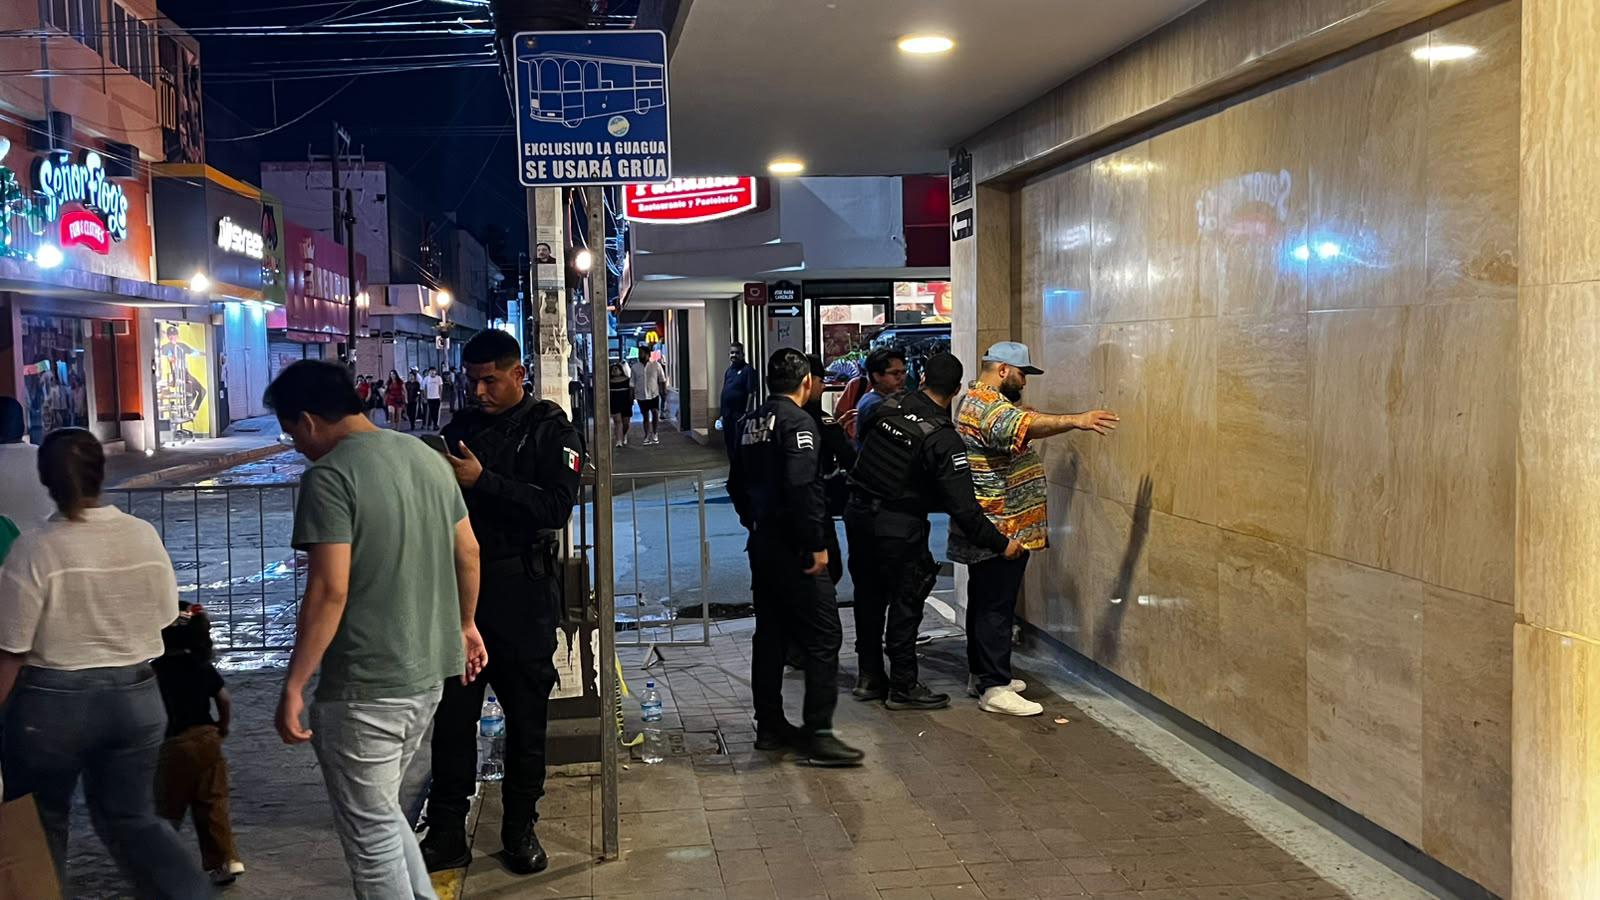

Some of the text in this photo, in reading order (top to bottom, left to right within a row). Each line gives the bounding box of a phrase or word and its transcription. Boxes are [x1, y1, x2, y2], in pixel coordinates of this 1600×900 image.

[525, 141, 666, 156] EXCLUSIVO LA GUAGUA
[525, 157, 667, 179] SE USARÁ GRÚA
[40, 152, 128, 239] Señor Frog's
